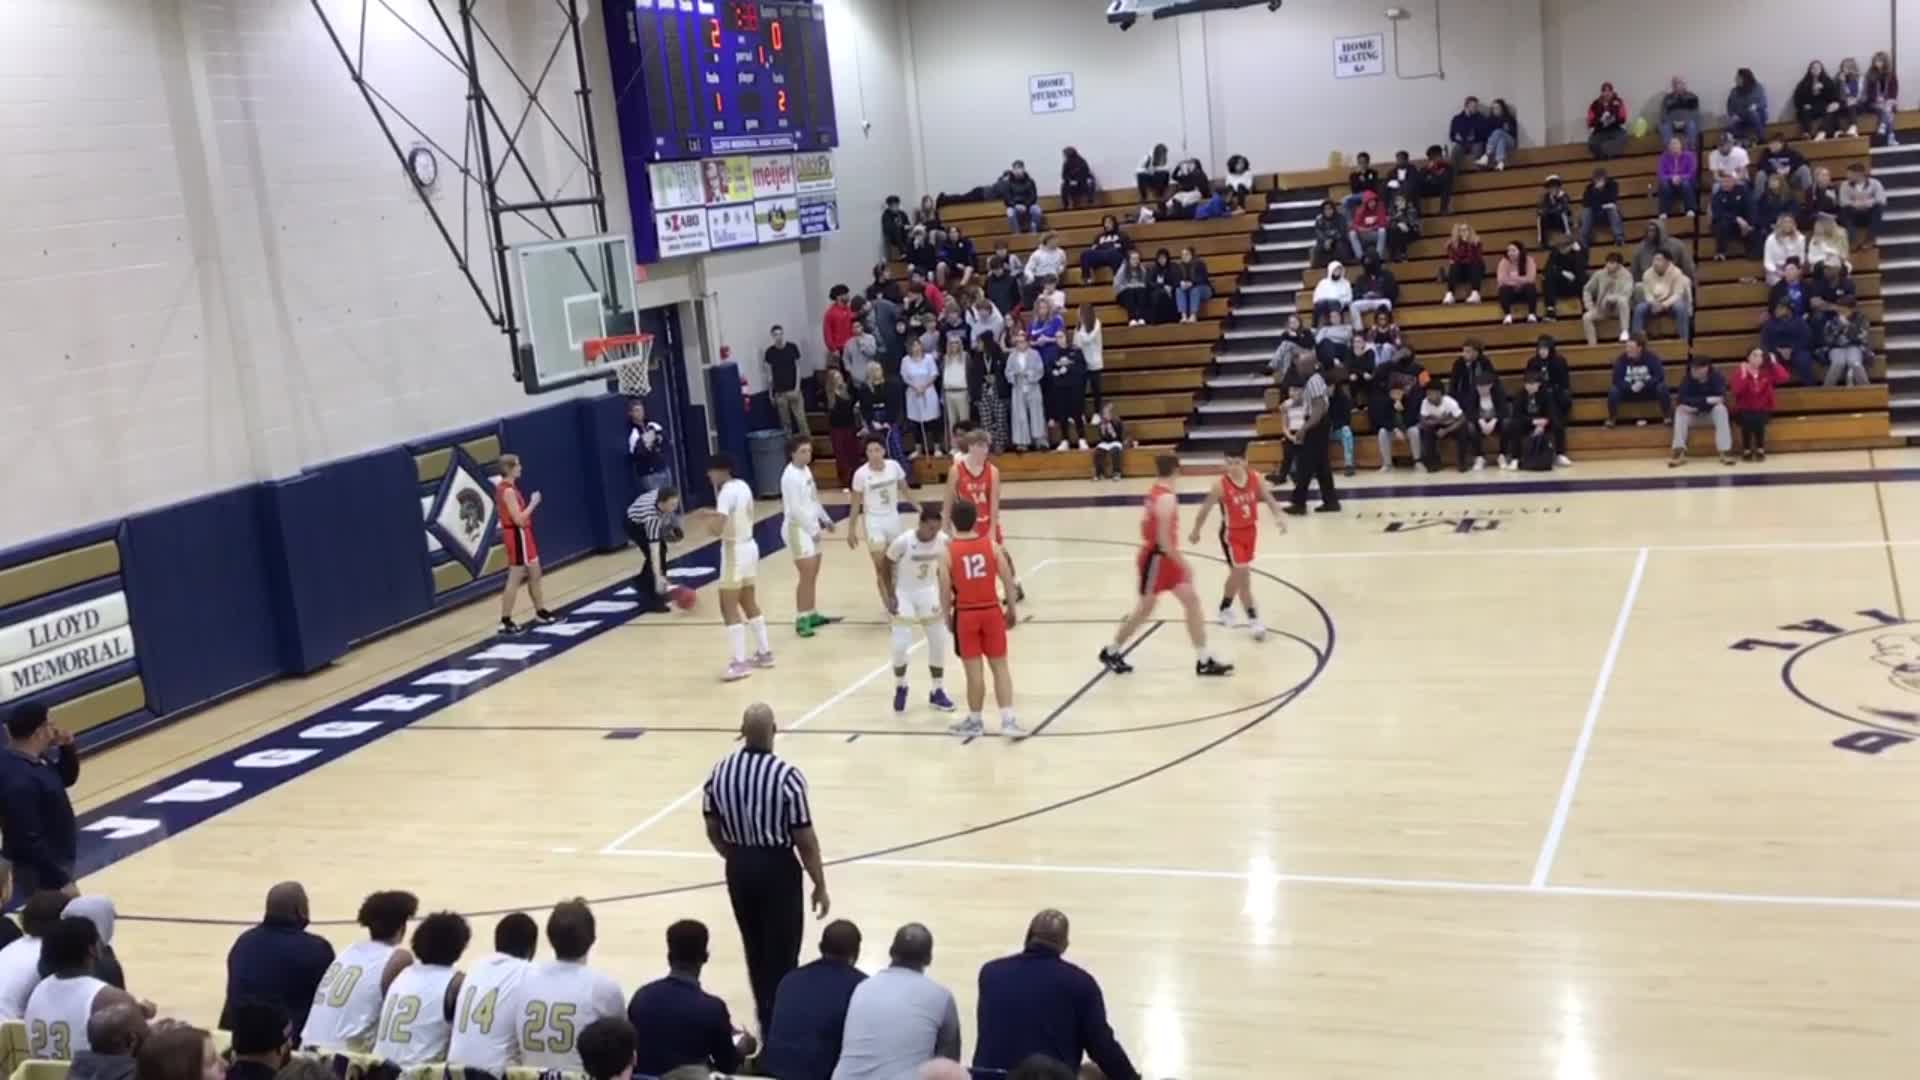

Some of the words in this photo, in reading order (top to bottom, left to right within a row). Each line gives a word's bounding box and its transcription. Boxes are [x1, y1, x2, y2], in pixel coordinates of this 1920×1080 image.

[709, 18, 720, 48] 2
[771, 21, 782, 50] 0
[1342, 39, 1375, 52] HOME
[1338, 50, 1379, 64] SEATING
[1031, 89, 1073, 101] STUDENTS
[1037, 78, 1065, 88] HOME
[778, 90, 786, 112] 2
[753, 166, 791, 192] meijer
[664, 214, 700, 232] SZABO
[971, 492, 987, 504] 14
[1241, 504, 1251, 519] 3
[962, 553, 988, 580] 12
[29, 608, 100, 648] LLOYD
[11, 636, 129, 692] MEMORIAL
[81, 566, 717, 839] JUGGERNAUS
[313, 961, 363, 1009] 20
[379, 993, 421, 1043] 12
[457, 985, 499, 1034] 14
[31, 1019, 71, 1060] 23
[522, 1000, 577, 1054] 25
